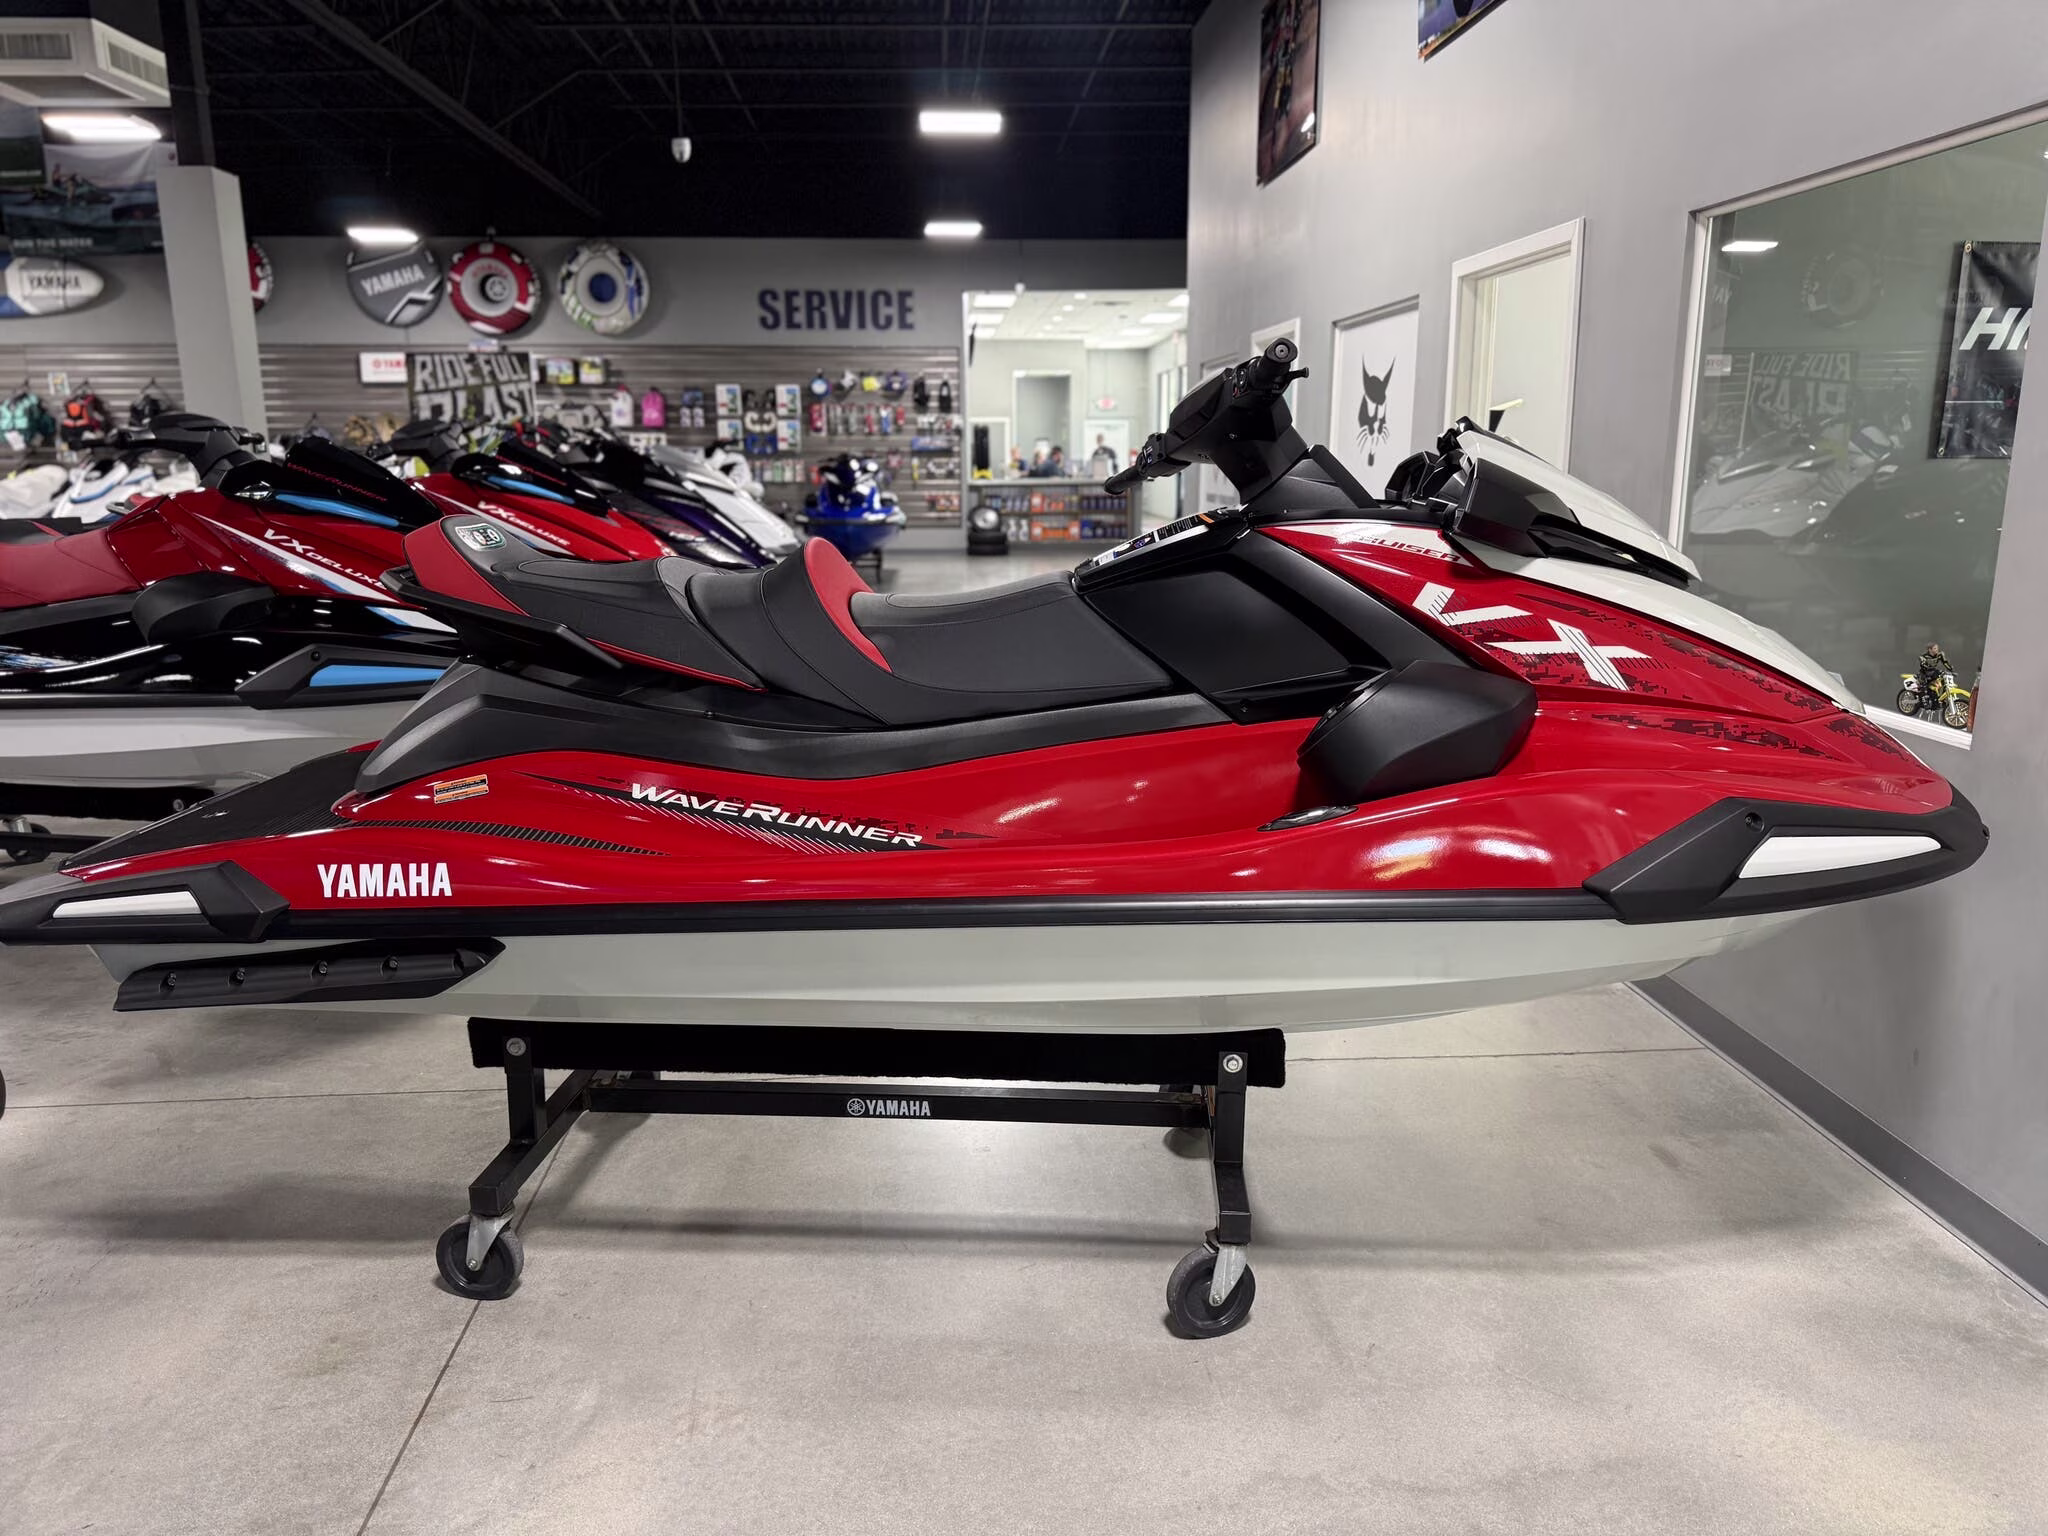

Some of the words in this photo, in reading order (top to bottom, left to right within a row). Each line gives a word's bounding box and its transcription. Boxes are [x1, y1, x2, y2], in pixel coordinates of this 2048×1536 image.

[28, 275, 82, 291] YAMAHA
[360, 264, 425, 296] YAMAHA
[757, 288, 915, 331] SERVICE
[413, 353, 482, 392] RIDE
[478, 353, 529, 383] FULL
[477, 500, 516, 520] VX
[263, 528, 316, 555] VX
[311, 551, 388, 590] DELUXE
[1357, 535, 1461, 563] UISER
[1411, 582, 1653, 691] VX
[316, 862, 453, 898] YAMAHA
[866, 1099, 931, 1116] YAMAHA
